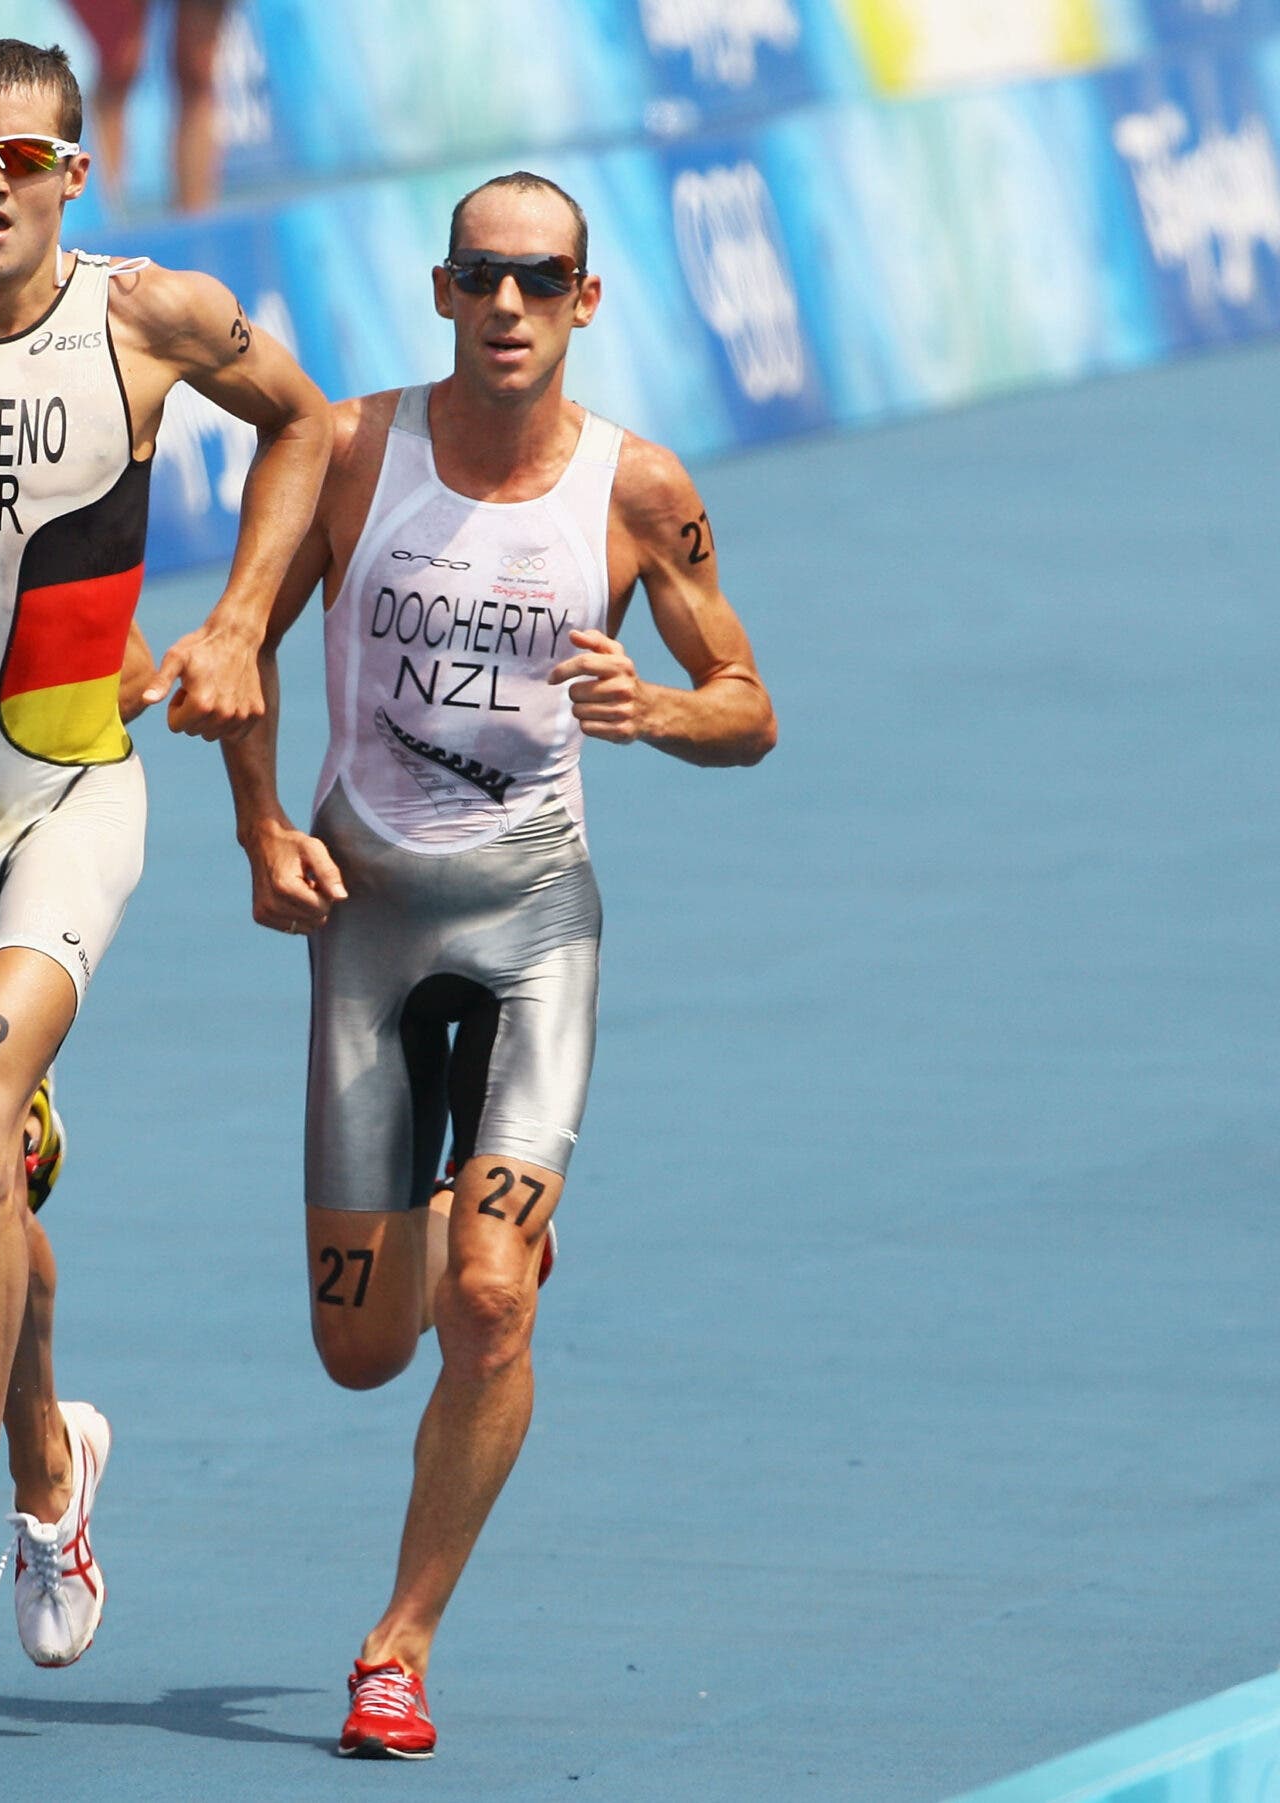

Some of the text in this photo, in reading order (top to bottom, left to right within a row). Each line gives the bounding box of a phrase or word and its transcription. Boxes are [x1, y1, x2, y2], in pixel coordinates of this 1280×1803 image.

[55, 331, 102, 351] asics
[371, 587, 568, 659] DOCHERTY
[393, 655, 521, 712] NZL
[478, 1166, 546, 1227] 27
[316, 1246, 374, 1308] 27
